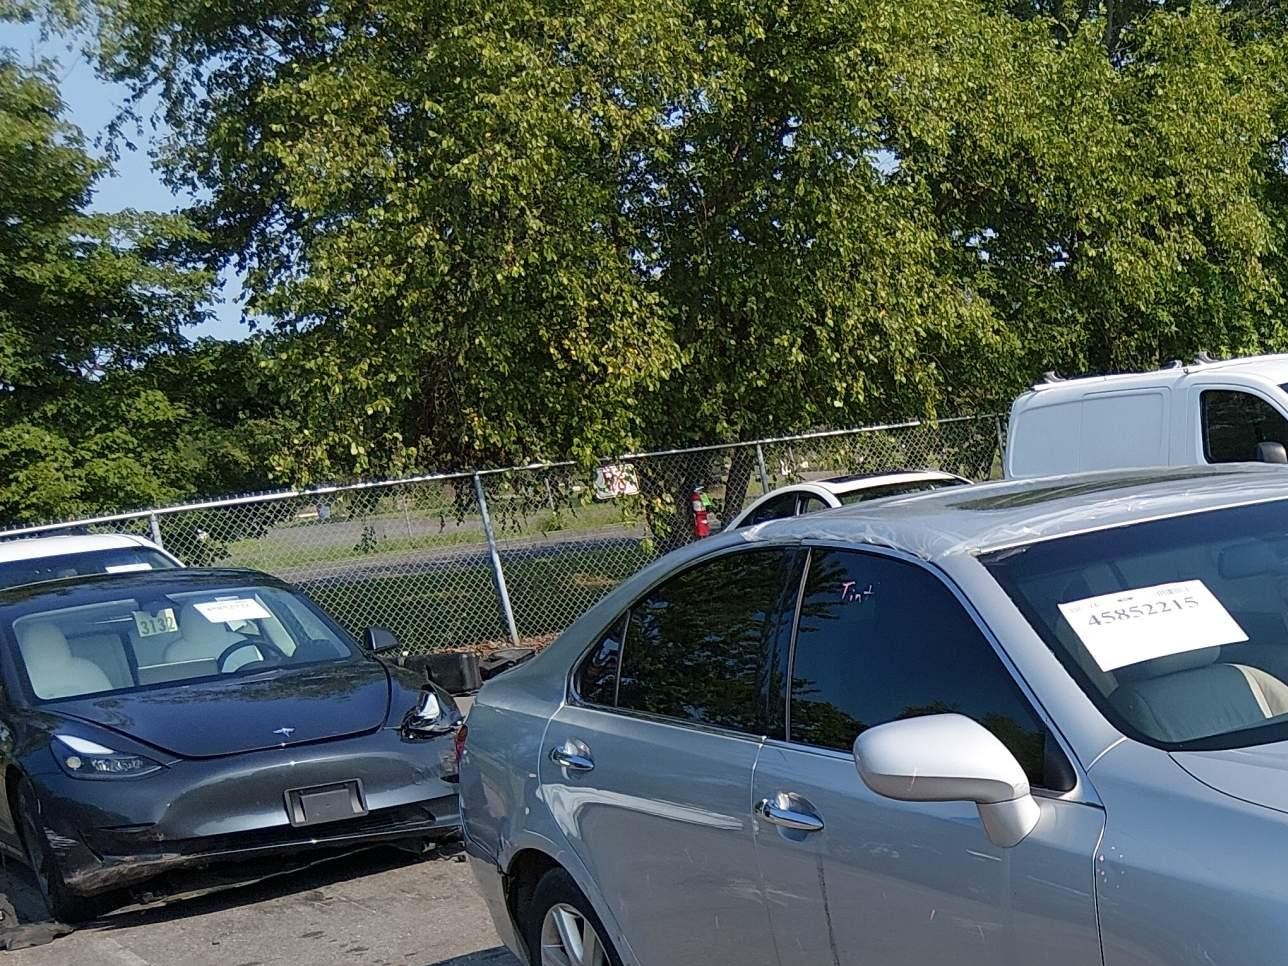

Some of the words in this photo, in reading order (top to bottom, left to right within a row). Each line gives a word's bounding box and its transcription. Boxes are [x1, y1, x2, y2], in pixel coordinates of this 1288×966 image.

[842, 581, 875, 603] Tint
[1089, 597, 1199, 625] 45852215
[141, 616, 176, 635] 3132
